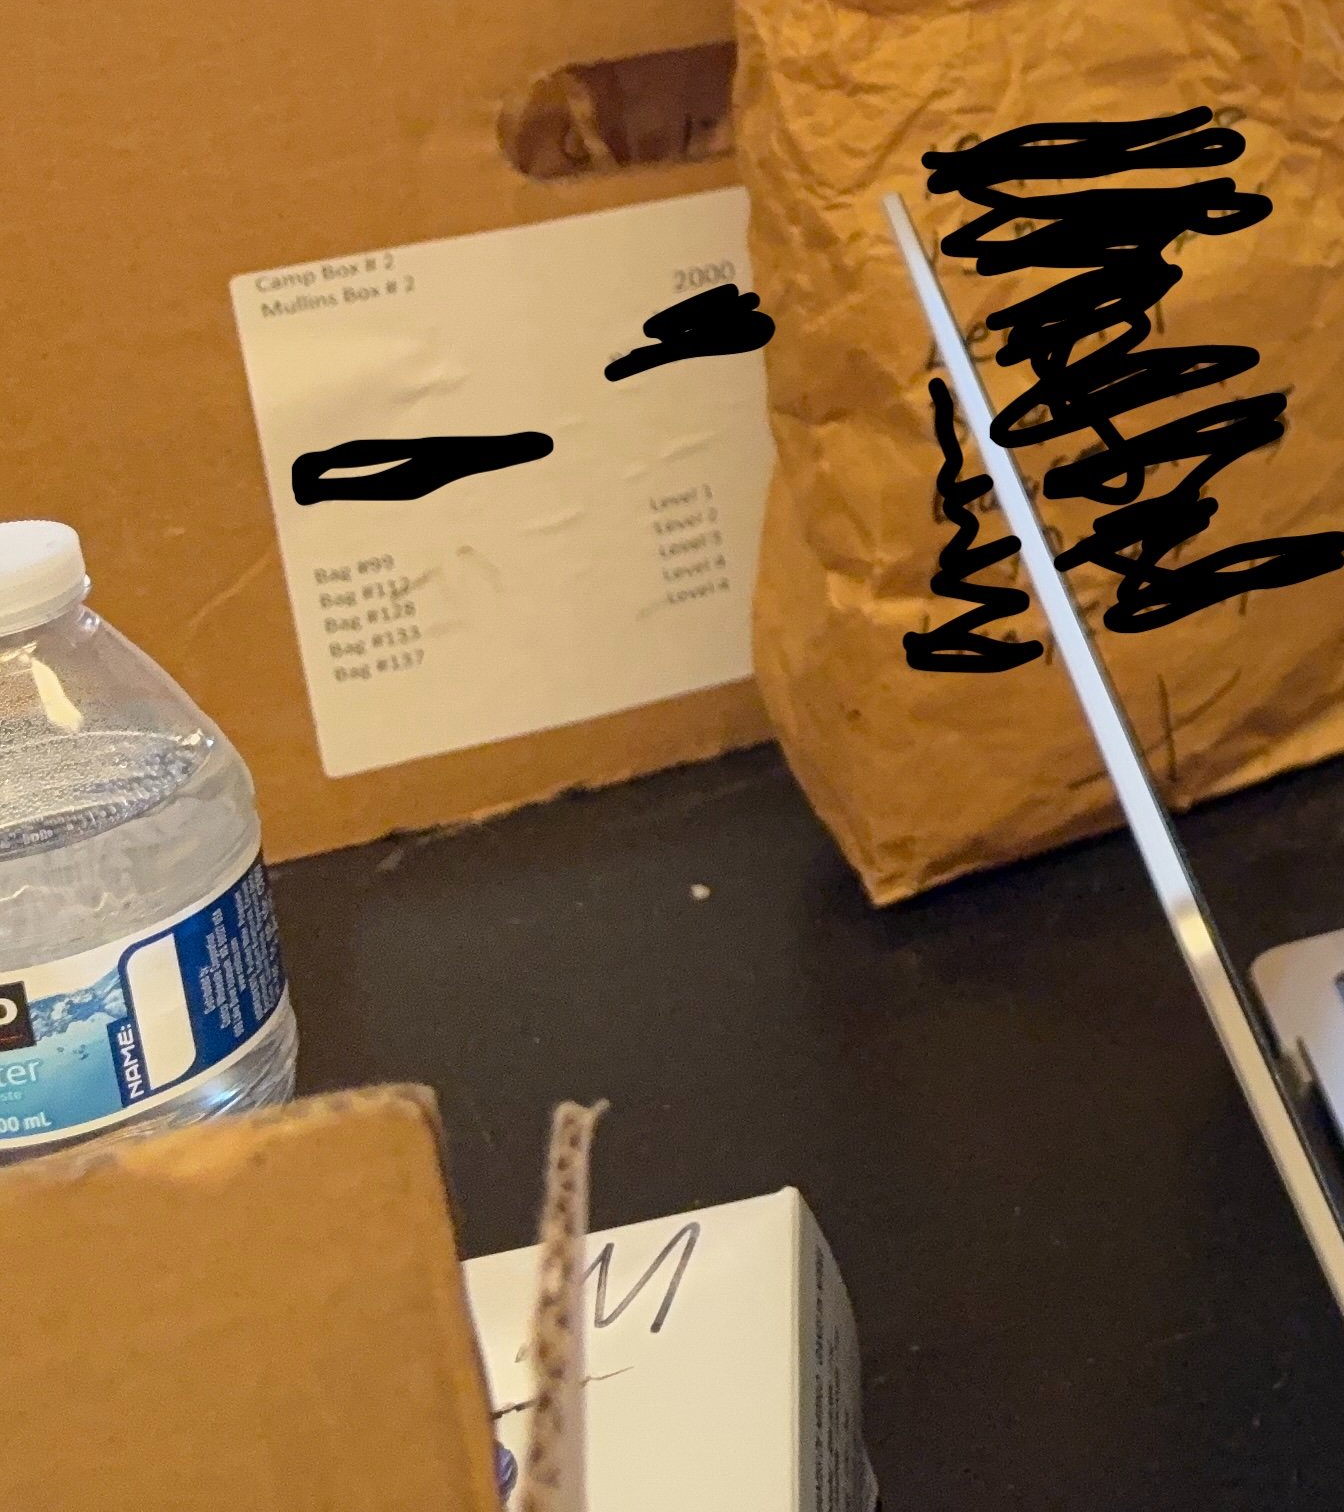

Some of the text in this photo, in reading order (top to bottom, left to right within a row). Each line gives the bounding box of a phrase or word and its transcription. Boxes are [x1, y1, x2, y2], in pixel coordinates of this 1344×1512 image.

[255, 251, 394, 292] Camp Box # 2
[673, 260, 737, 293] 2000
[261, 274, 416, 318] Mullins Box # 2
[314, 566, 352, 585] Bag
[320, 591, 357, 609] Bag
[324, 616, 362, 634] Bag
[329, 640, 367, 658] Bag
[334, 664, 372, 682] Bag
[117, 1023, 145, 1099] NAME:
[23, 1111, 52, 1131] mL
